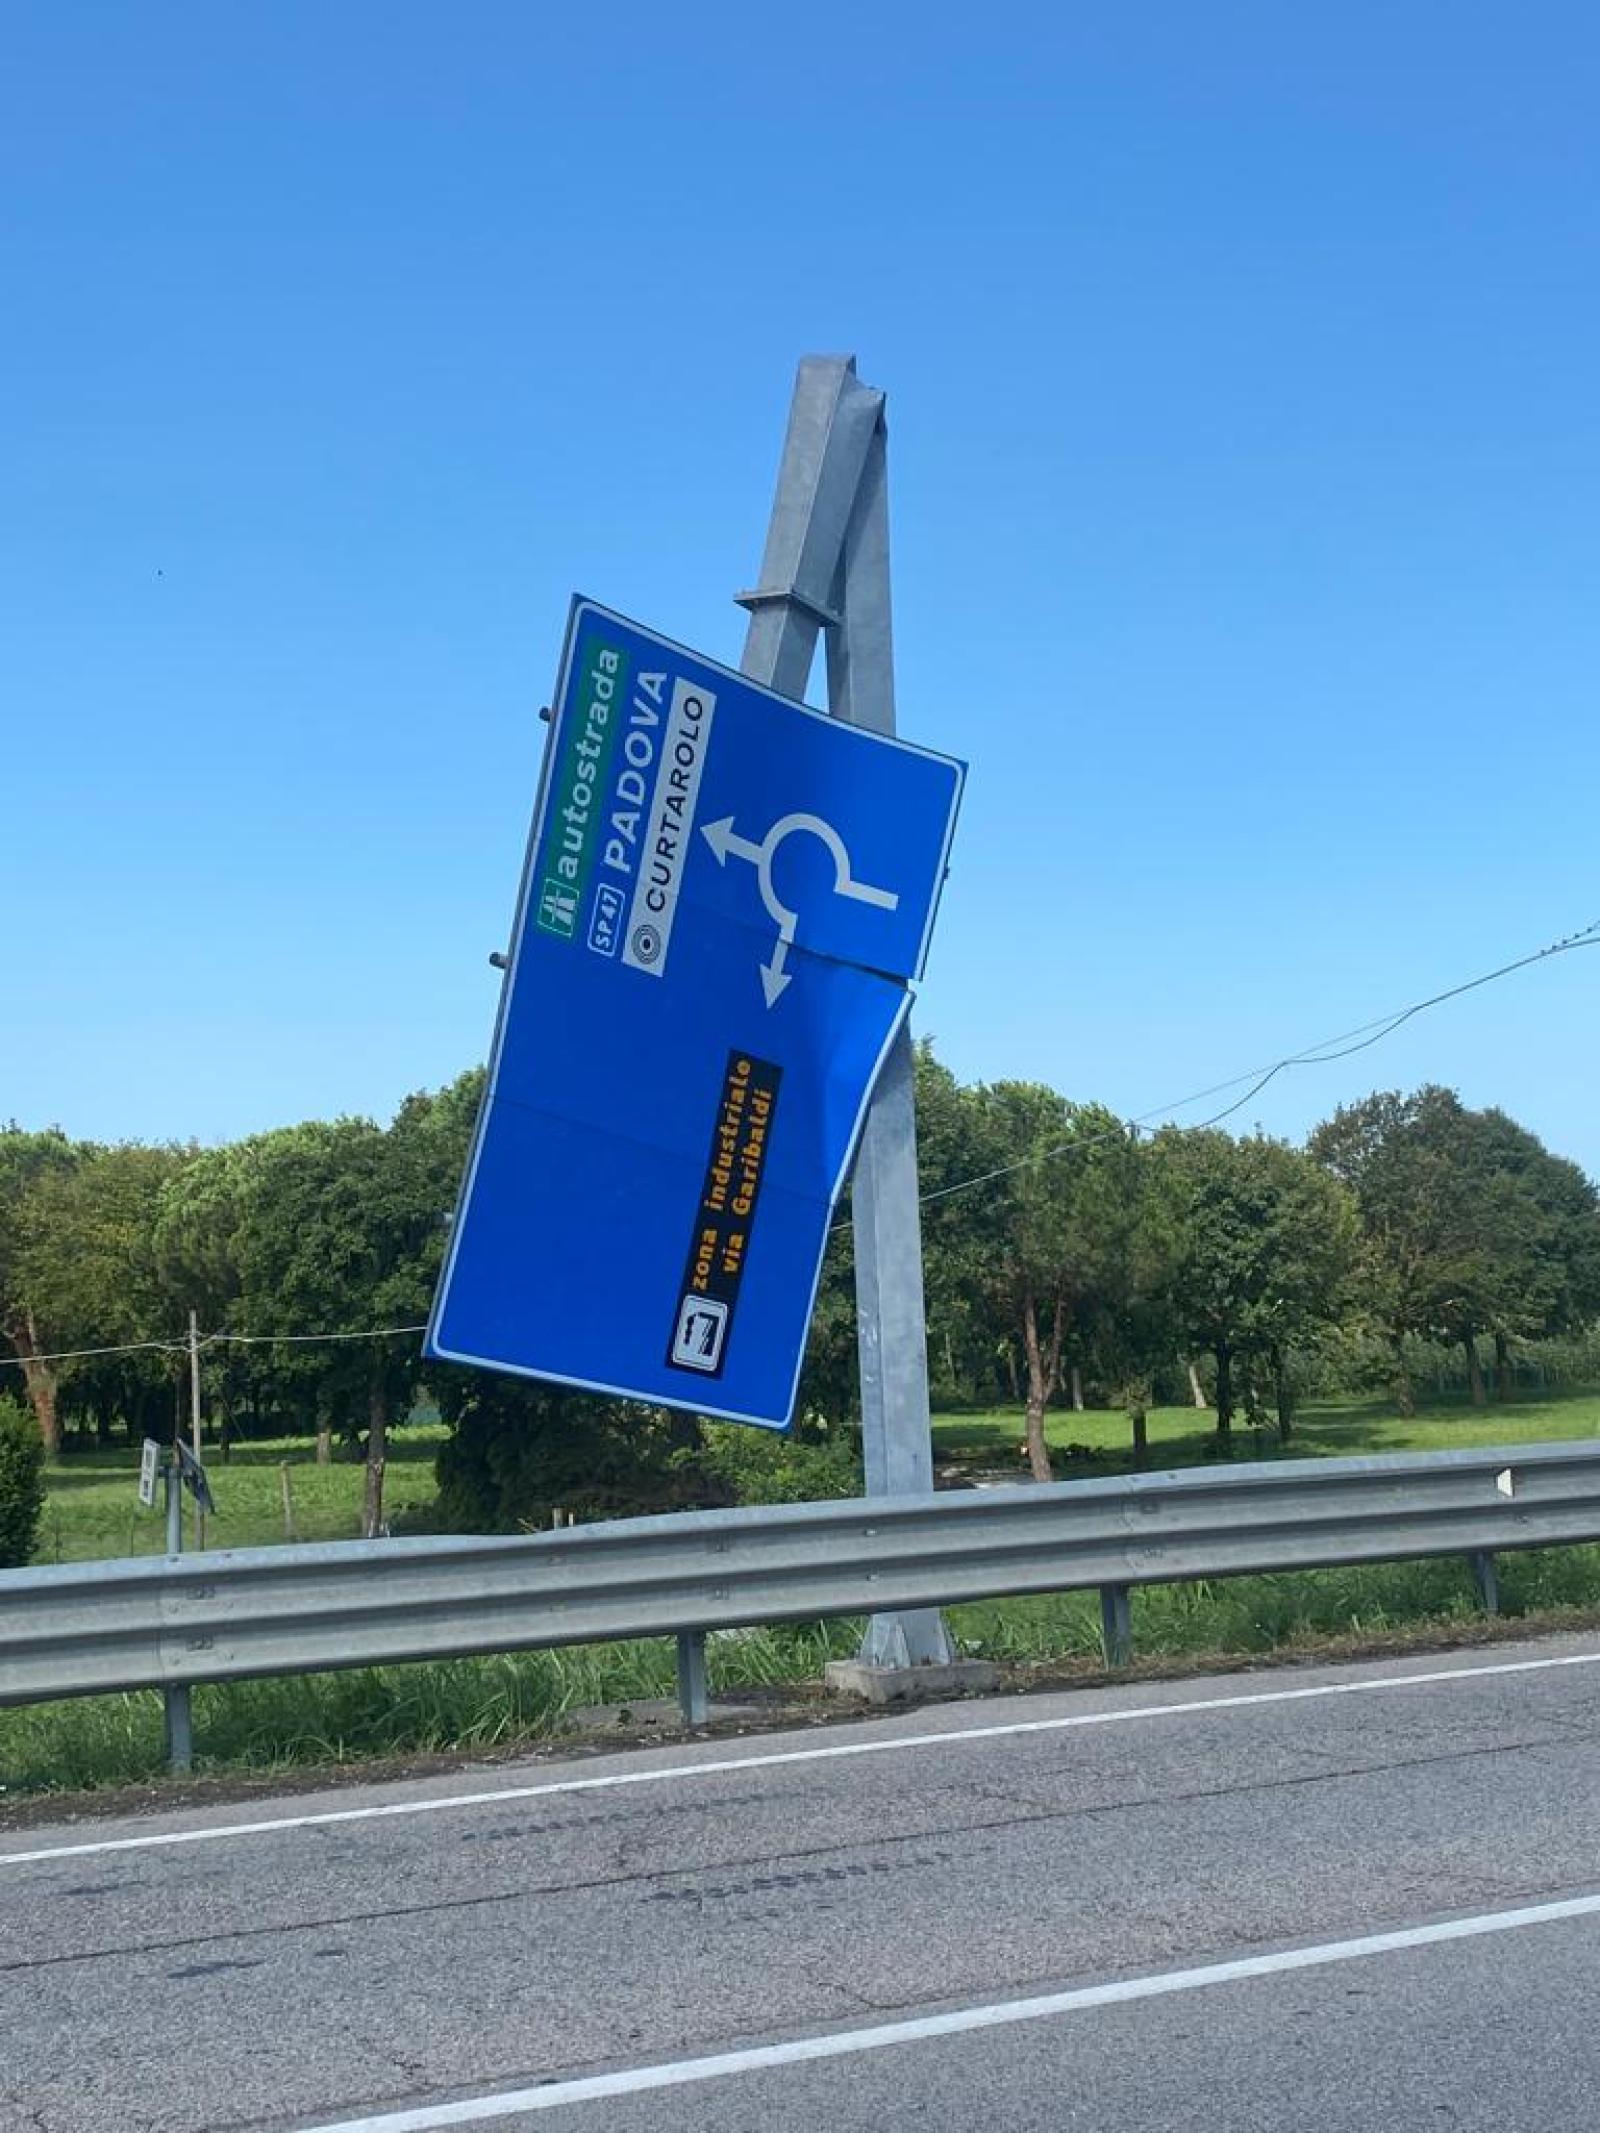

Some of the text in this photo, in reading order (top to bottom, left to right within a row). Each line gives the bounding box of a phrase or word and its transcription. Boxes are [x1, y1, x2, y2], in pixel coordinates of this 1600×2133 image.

[558, 649, 619, 878] autostrada
[603, 672, 667, 873] PADOVA
[646, 696, 703, 912] CURTAROLO
[693, 1229, 718, 1290] zona
[723, 1088, 772, 1272] via Garibaldi
